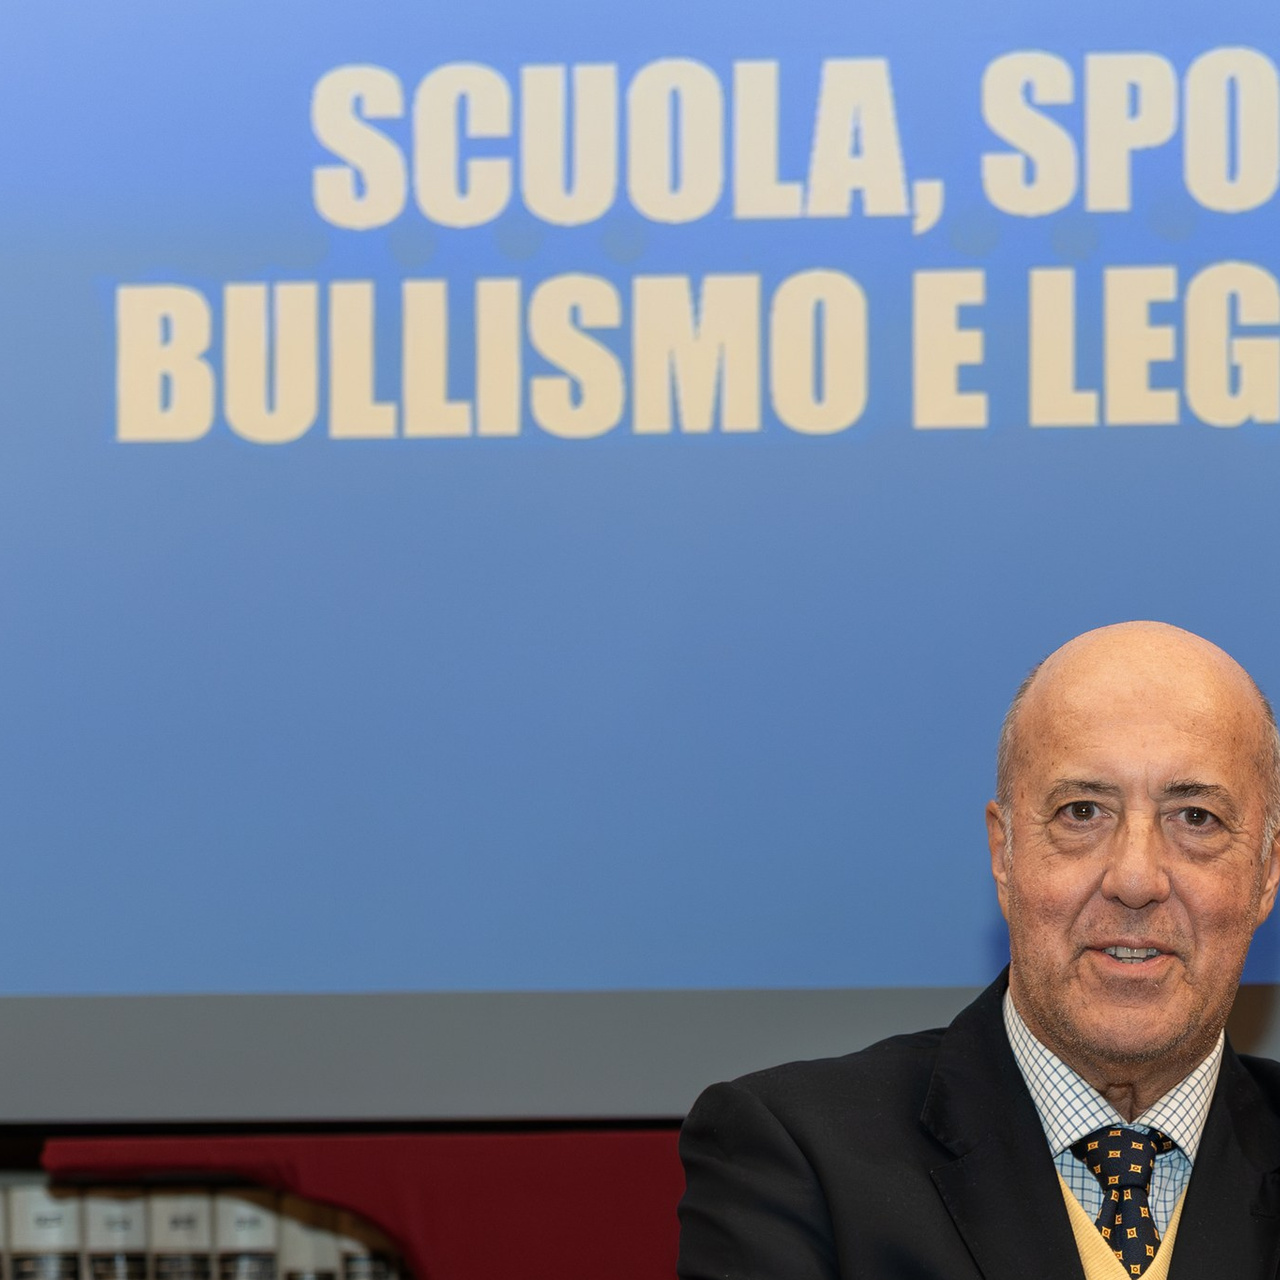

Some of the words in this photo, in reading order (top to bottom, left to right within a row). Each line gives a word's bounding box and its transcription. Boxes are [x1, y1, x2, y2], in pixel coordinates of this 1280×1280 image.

[311, 59, 943, 233] SCUOLA,
[116, 269, 869, 445] BULLISMO
[912, 269, 988, 430] E
